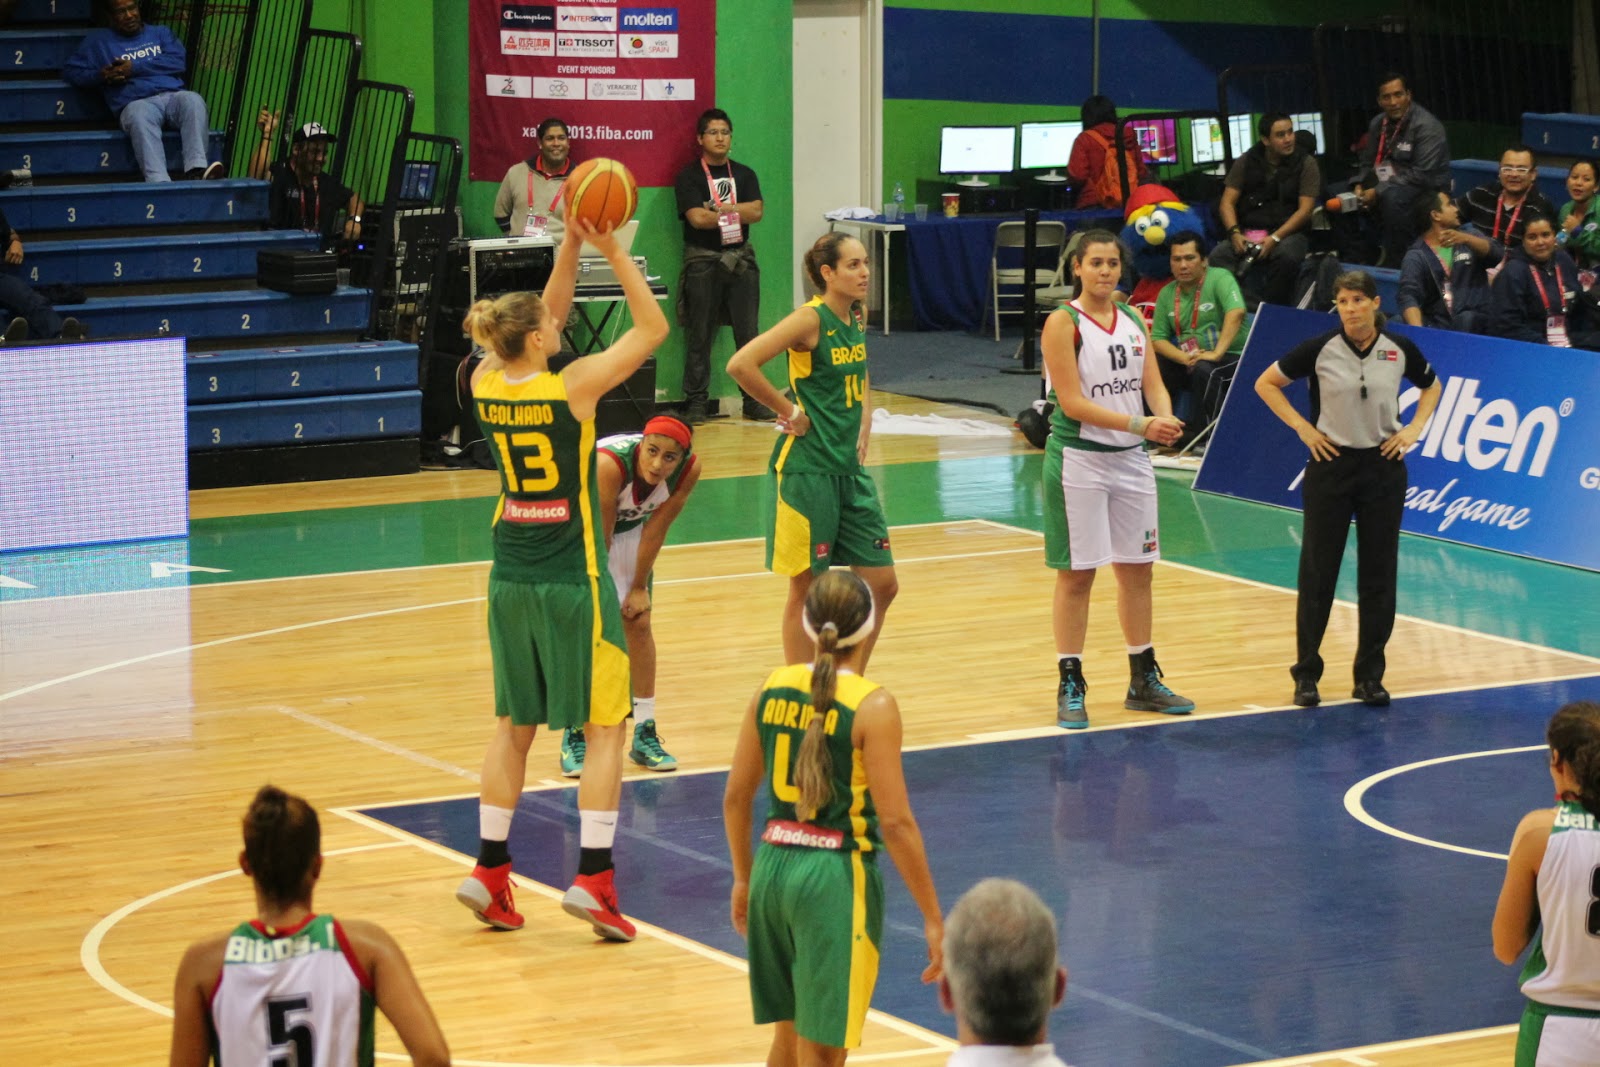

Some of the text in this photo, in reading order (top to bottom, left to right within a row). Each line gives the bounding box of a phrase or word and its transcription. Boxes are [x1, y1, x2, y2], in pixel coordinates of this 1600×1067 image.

[50, 0, 56, 14] 1
[503, 10, 552, 23] Champion
[624, 13, 672, 26] molten
[574, 39, 614, 47] TISSOT
[15, 50, 23, 65] 2
[557, 65, 616, 75] EVENT SPONSORS
[57, 100, 65, 115] 2
[23, 154, 32, 170] 3
[101, 152, 109, 167] 2
[67, 207, 76, 223] 3
[146, 204, 155, 219] 2
[227, 200, 233, 215] 1
[114, 262, 122, 277] 3
[193, 257, 202, 272] 2
[30, 266, 39, 281] 4
[241, 314, 250, 329] 2
[324, 308, 331, 324] 1
[1107, 344, 1127, 371] 13
[291, 371, 300, 387] 2
[374, 365, 381, 381] 1
[209, 376, 218, 392] 3
[294, 422, 303, 438] 2
[377, 417, 385, 432] 1
[211, 428, 221, 444] 3
[493, 431, 560, 493] 13
[1579, 467, 1600, 490] G
[511, 505, 566, 519] Bradesco
[1403, 478, 1531, 532] eal game
[771, 824, 838, 850] Bradesco
[266, 992, 318, 1067] 5
